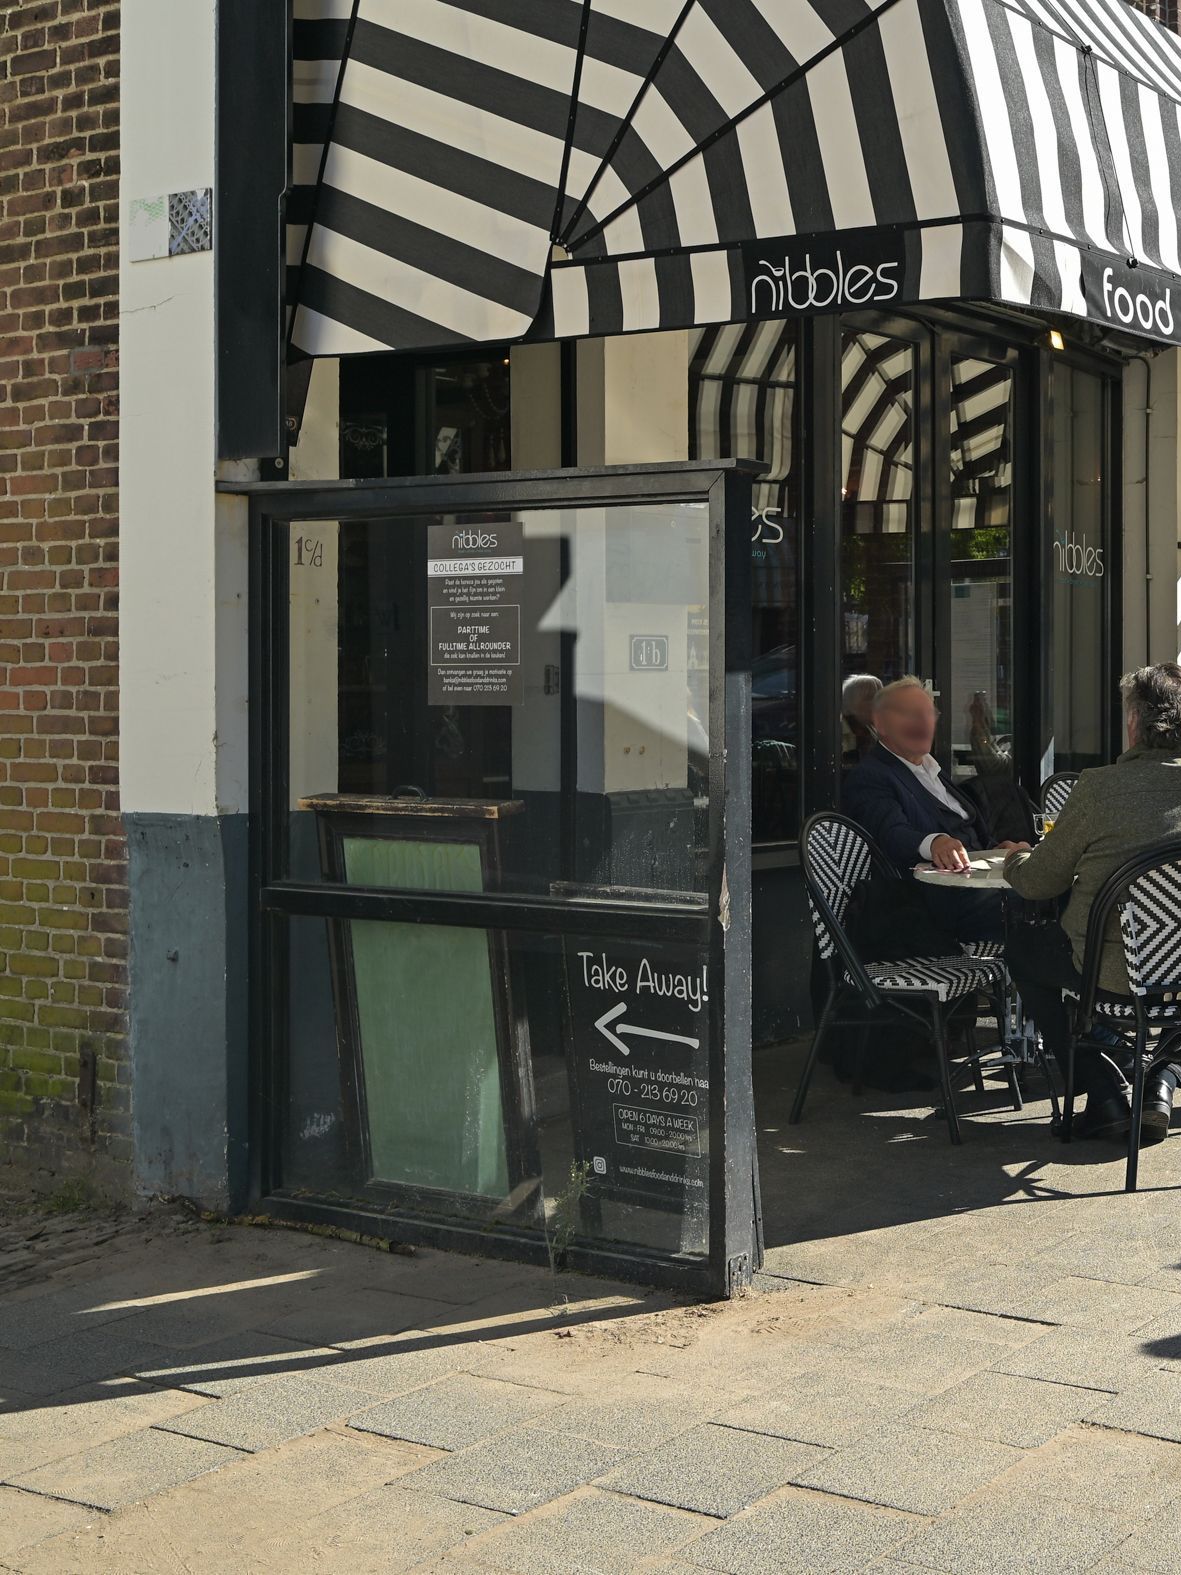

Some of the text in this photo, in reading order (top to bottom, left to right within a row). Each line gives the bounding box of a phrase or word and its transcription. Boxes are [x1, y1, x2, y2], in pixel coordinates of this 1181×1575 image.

[751, 250, 899, 314] nibbles
[1103, 267, 1174, 335] food
[452, 529, 498, 549] nibbles
[1053, 530, 1104, 577] nibbles
[433, 561, 516, 573] COLLEGA'S GEZOCHT
[457, 625, 490, 634] PARTTIME
[469, 634, 478, 642] OF
[438, 642, 511, 650] FULLTIME ALLROUNDER
[577, 951, 709, 1012] Take Away!
[589, 1058, 709, 1089] Bestellingen kunt u doorbellen naa
[607, 1078, 631, 1095] 070
[640, 1083, 660, 1100] 213
[662, 1087, 678, 1103] 69
[680, 1089, 698, 1106] 20
[618, 1108, 695, 1132] OPEN 6 DAYS A WEEK
